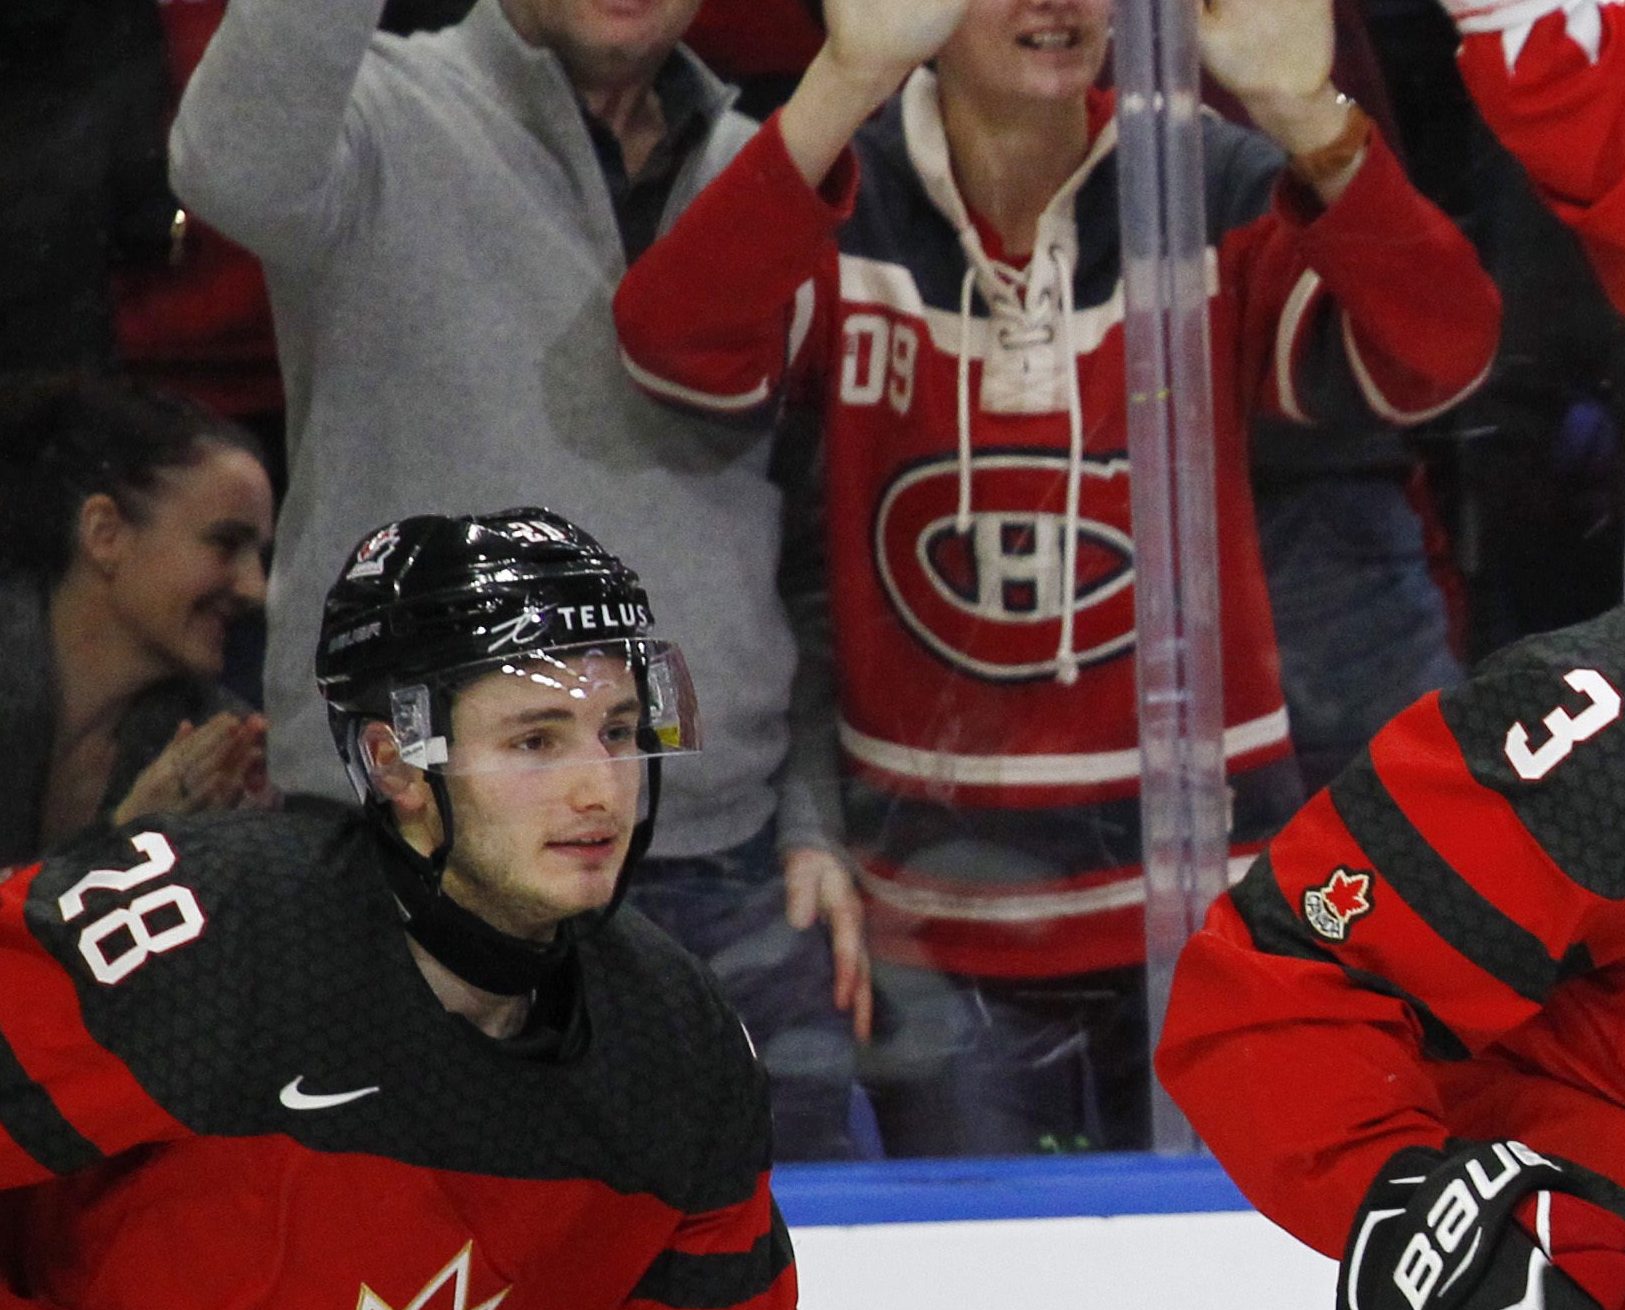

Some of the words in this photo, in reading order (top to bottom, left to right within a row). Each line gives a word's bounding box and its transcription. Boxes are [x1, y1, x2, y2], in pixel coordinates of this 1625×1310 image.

[557, 603, 645, 630] TELUS
[1504, 668, 1621, 780] 3
[57, 830, 206, 984] 28
